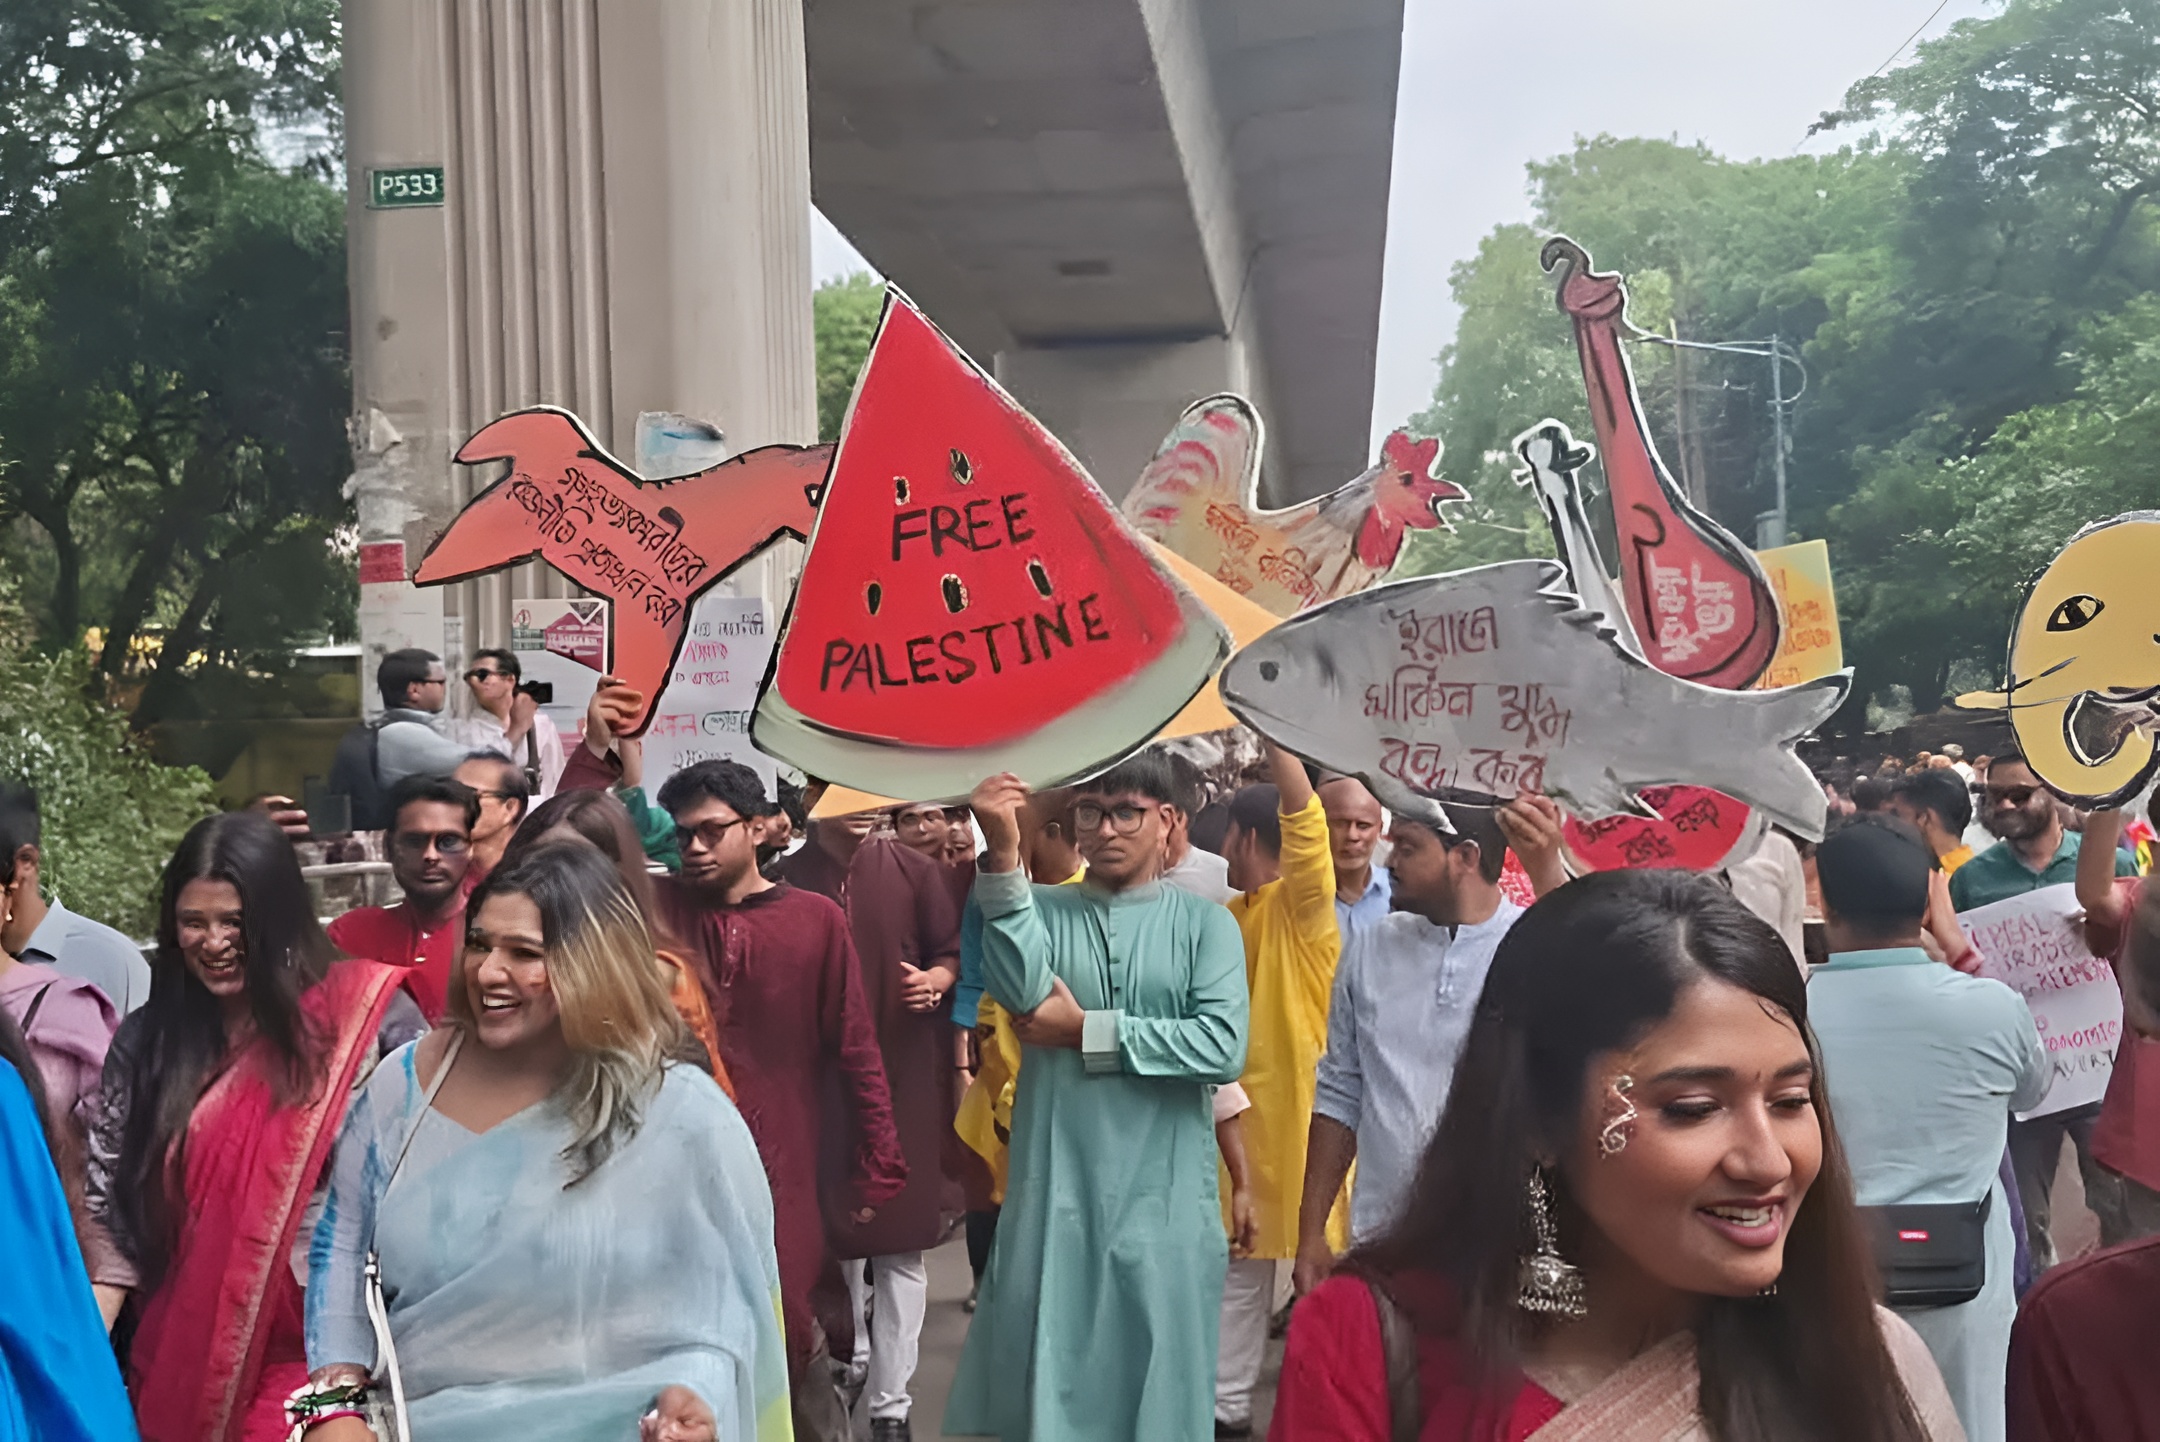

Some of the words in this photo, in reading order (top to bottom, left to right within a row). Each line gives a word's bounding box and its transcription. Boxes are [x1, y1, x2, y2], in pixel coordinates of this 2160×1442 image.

[380, 173, 437, 197] P533
[891, 492, 1036, 562] FREE
[819, 593, 1111, 694] PALESTINE
